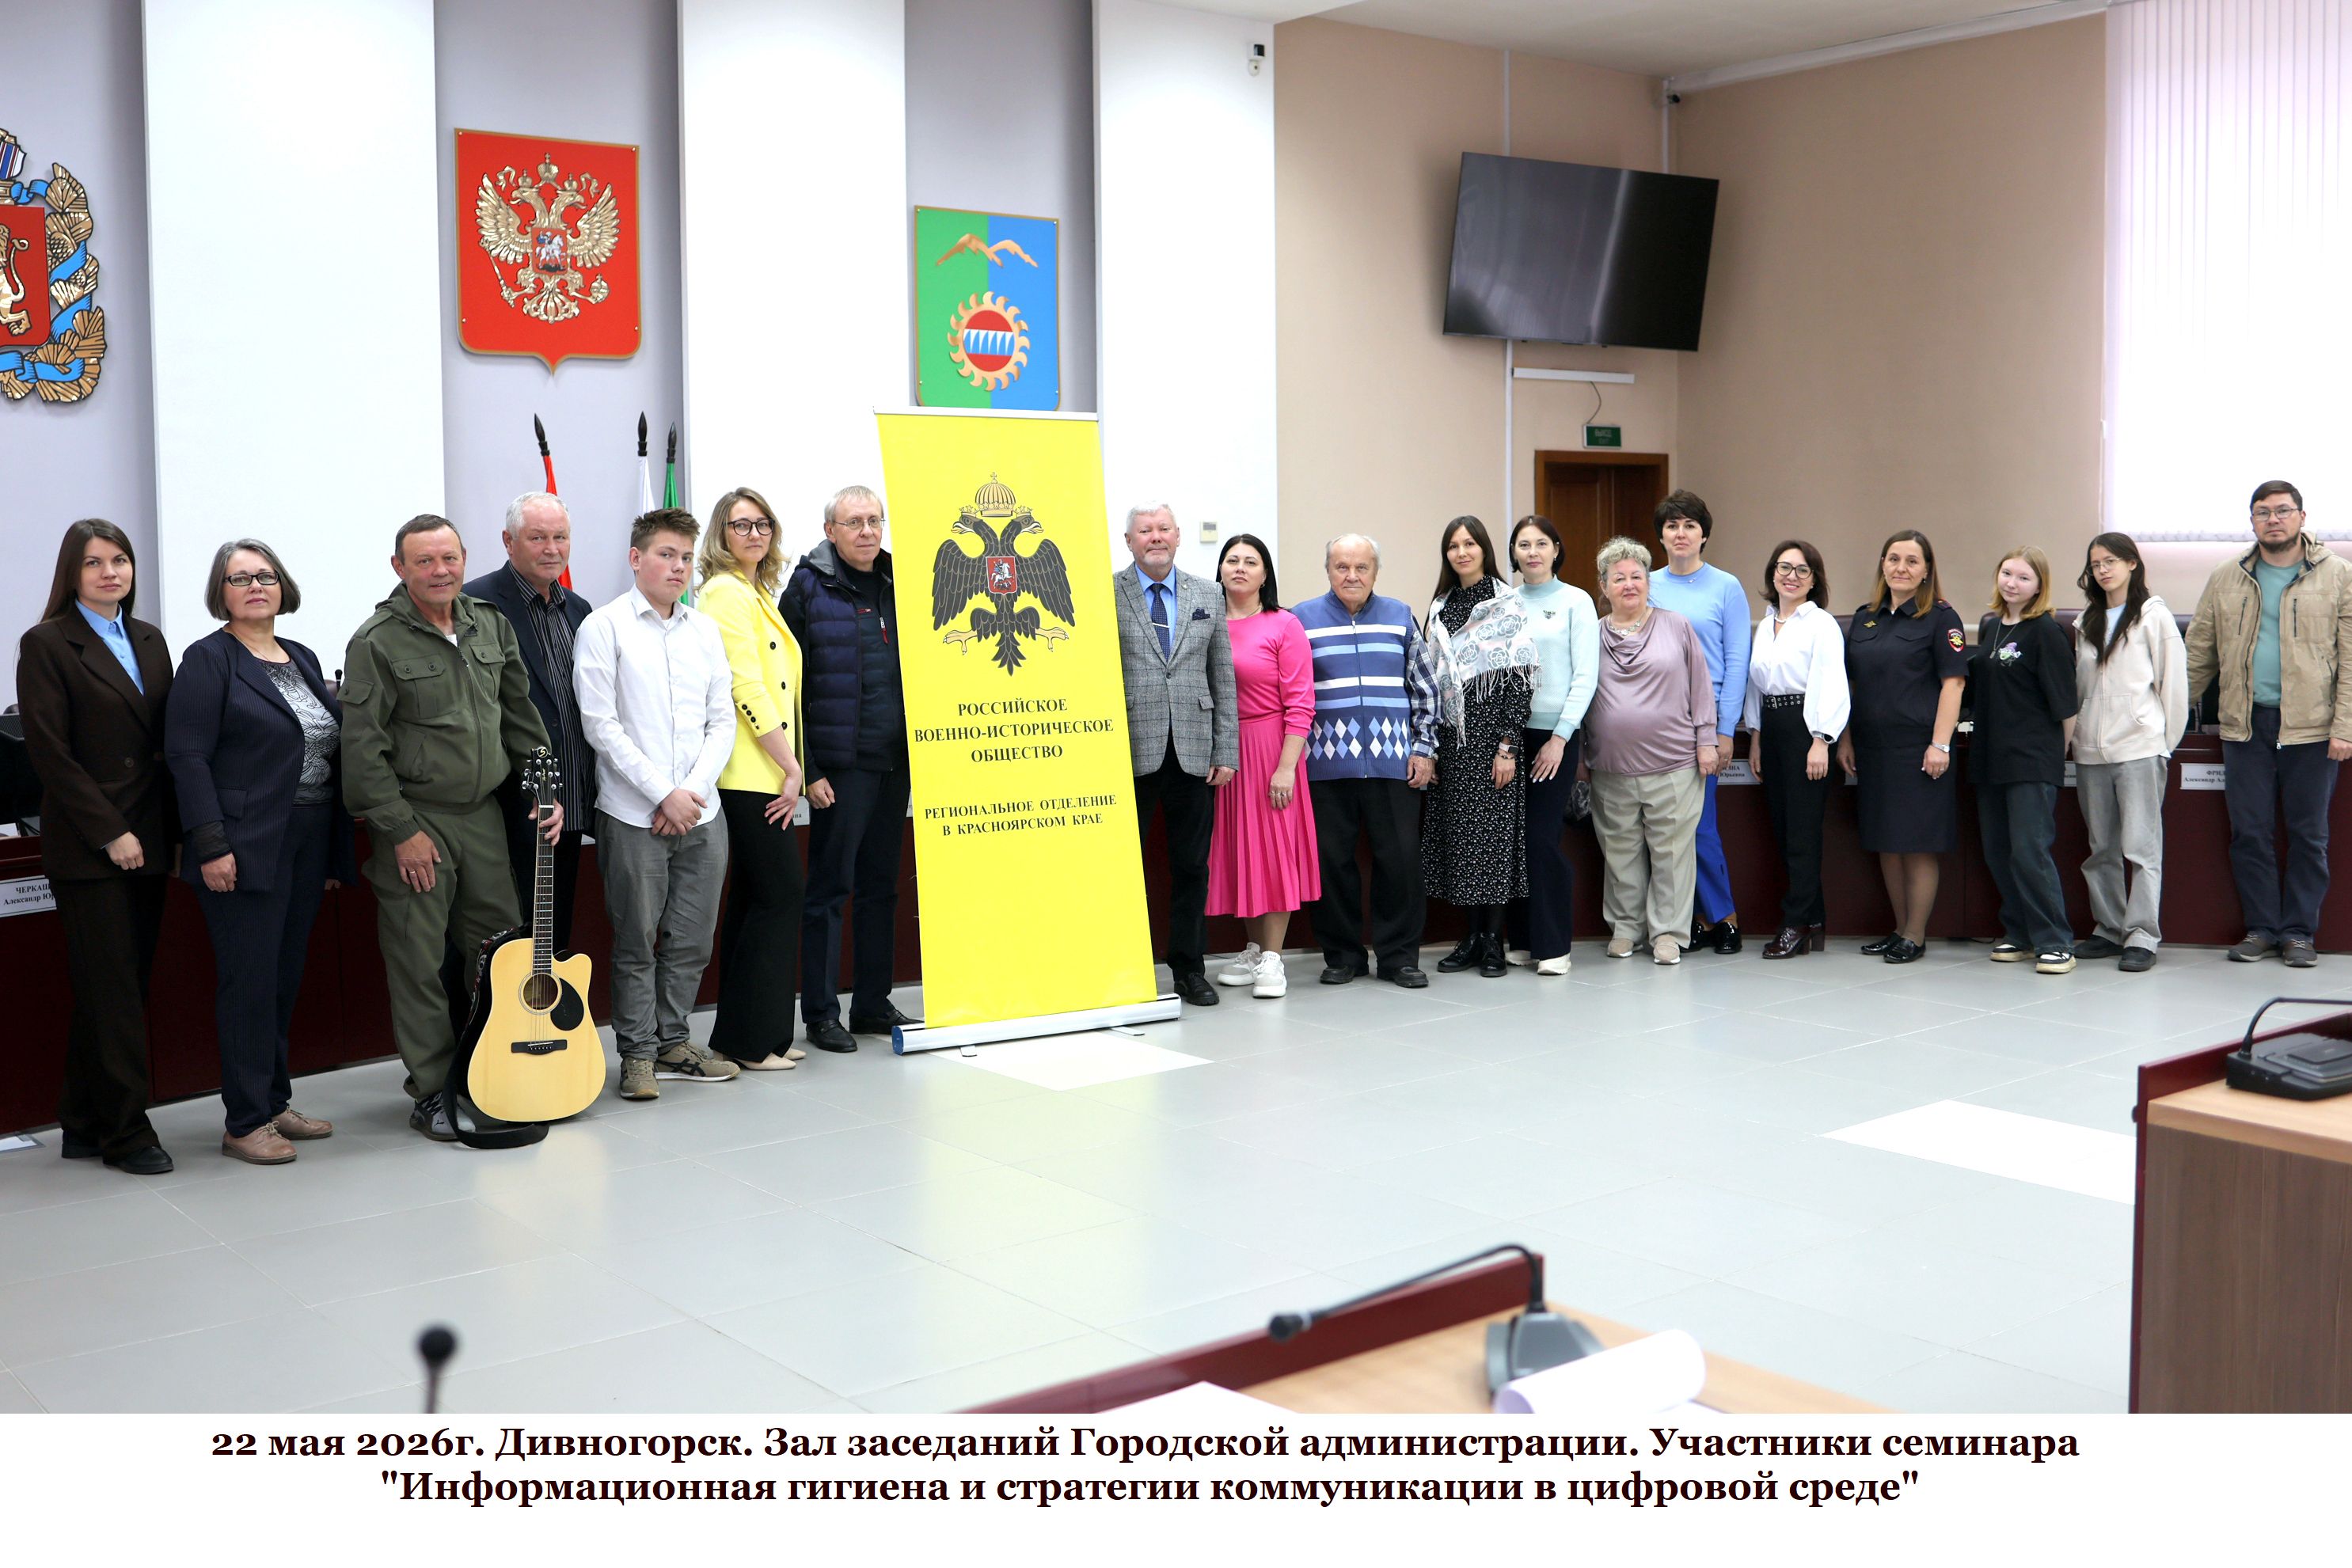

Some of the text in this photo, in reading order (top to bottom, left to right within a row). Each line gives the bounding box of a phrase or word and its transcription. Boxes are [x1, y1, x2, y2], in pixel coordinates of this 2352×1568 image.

[958, 697, 1069, 716] РОССИЙСКОЕ
[914, 719, 1115, 742] ВОЕННО-ИСТОРИЧЕСКОЕ
[971, 744, 1064, 763] ОБЩЕСТВО
[924, 794, 1117, 819] РЕГИОНАЛЬНОЕ ОТДЕЛЕНИЕ
[942, 812, 1103, 836] В КРАСНОЯРСКОМ КРАЕ
[4, 895, 41, 905] Александр
